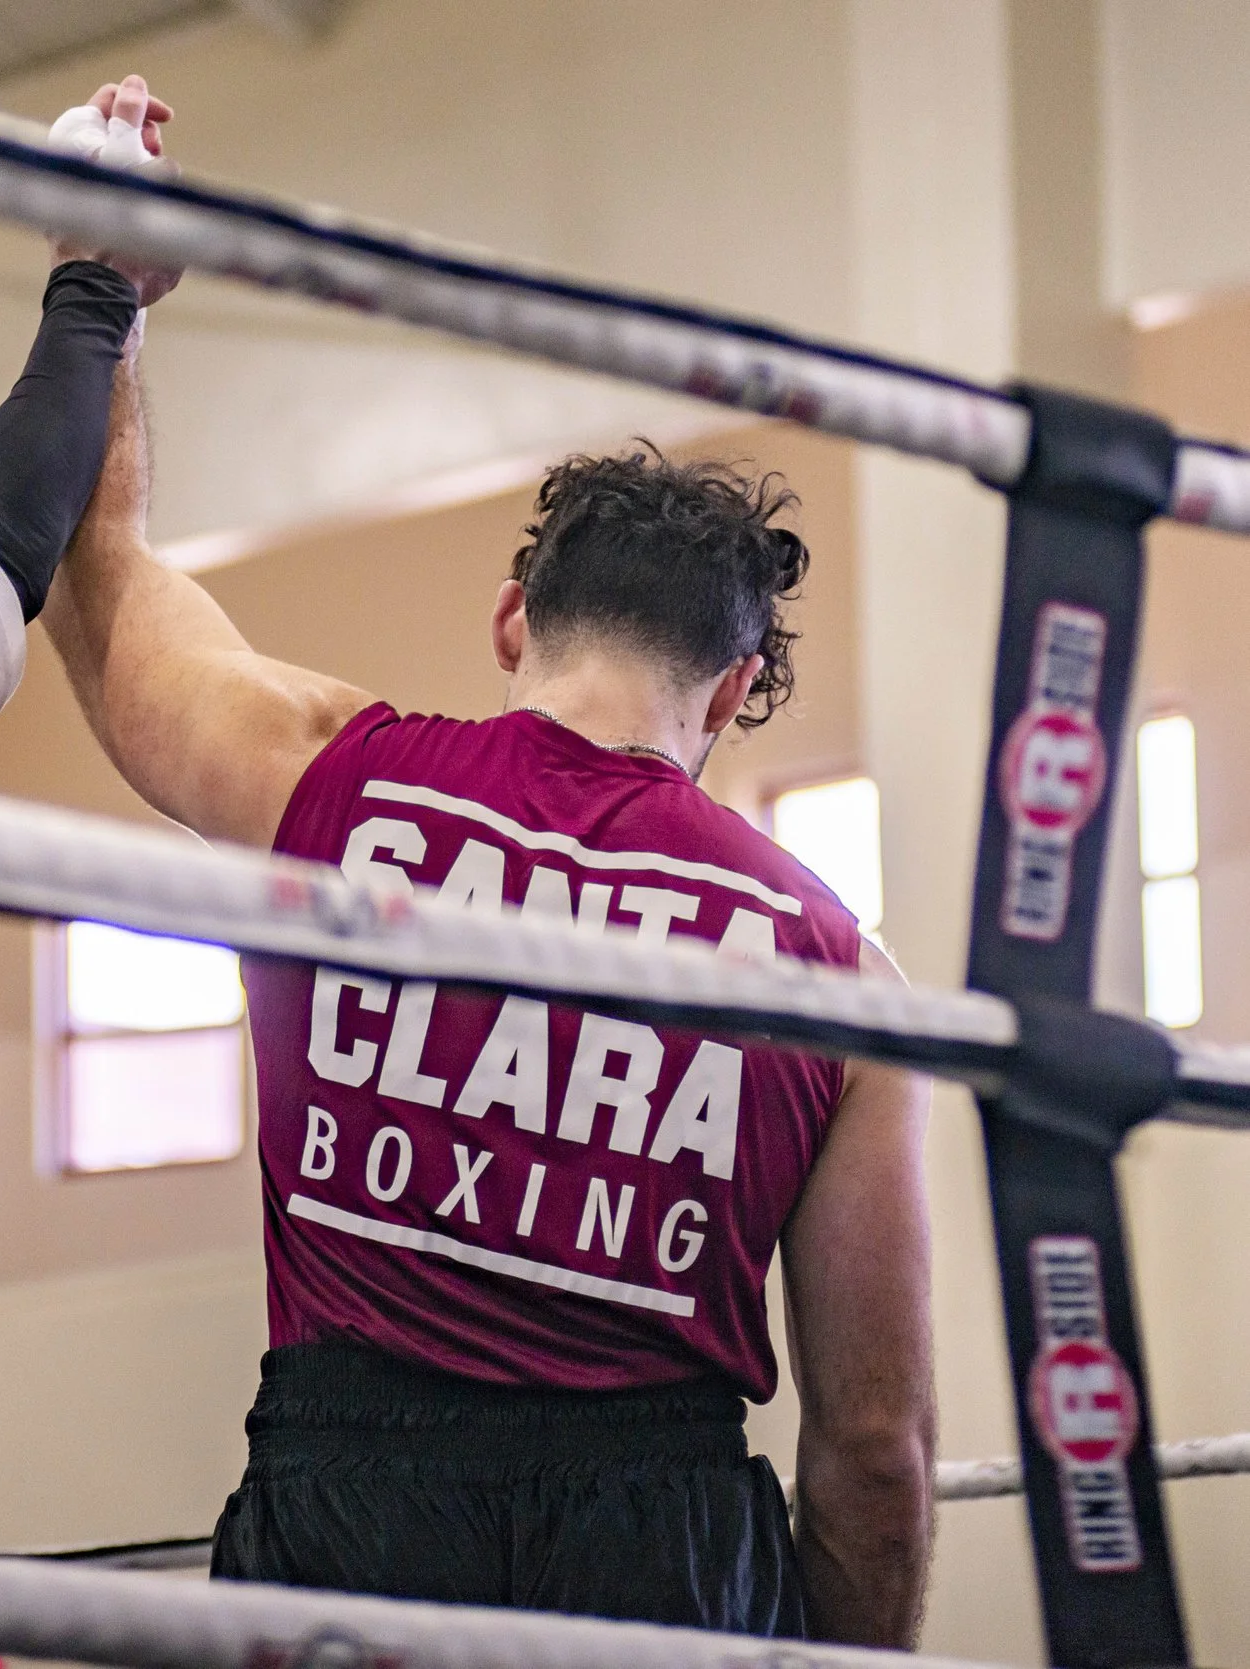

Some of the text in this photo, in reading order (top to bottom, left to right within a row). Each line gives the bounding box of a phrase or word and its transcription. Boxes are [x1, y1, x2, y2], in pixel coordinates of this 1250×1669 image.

[306, 964, 744, 1182] CLARA
[299, 1105, 709, 1274] BOXING
[1049, 1363, 1120, 1441] R
[1069, 1470, 1127, 1562] RING
